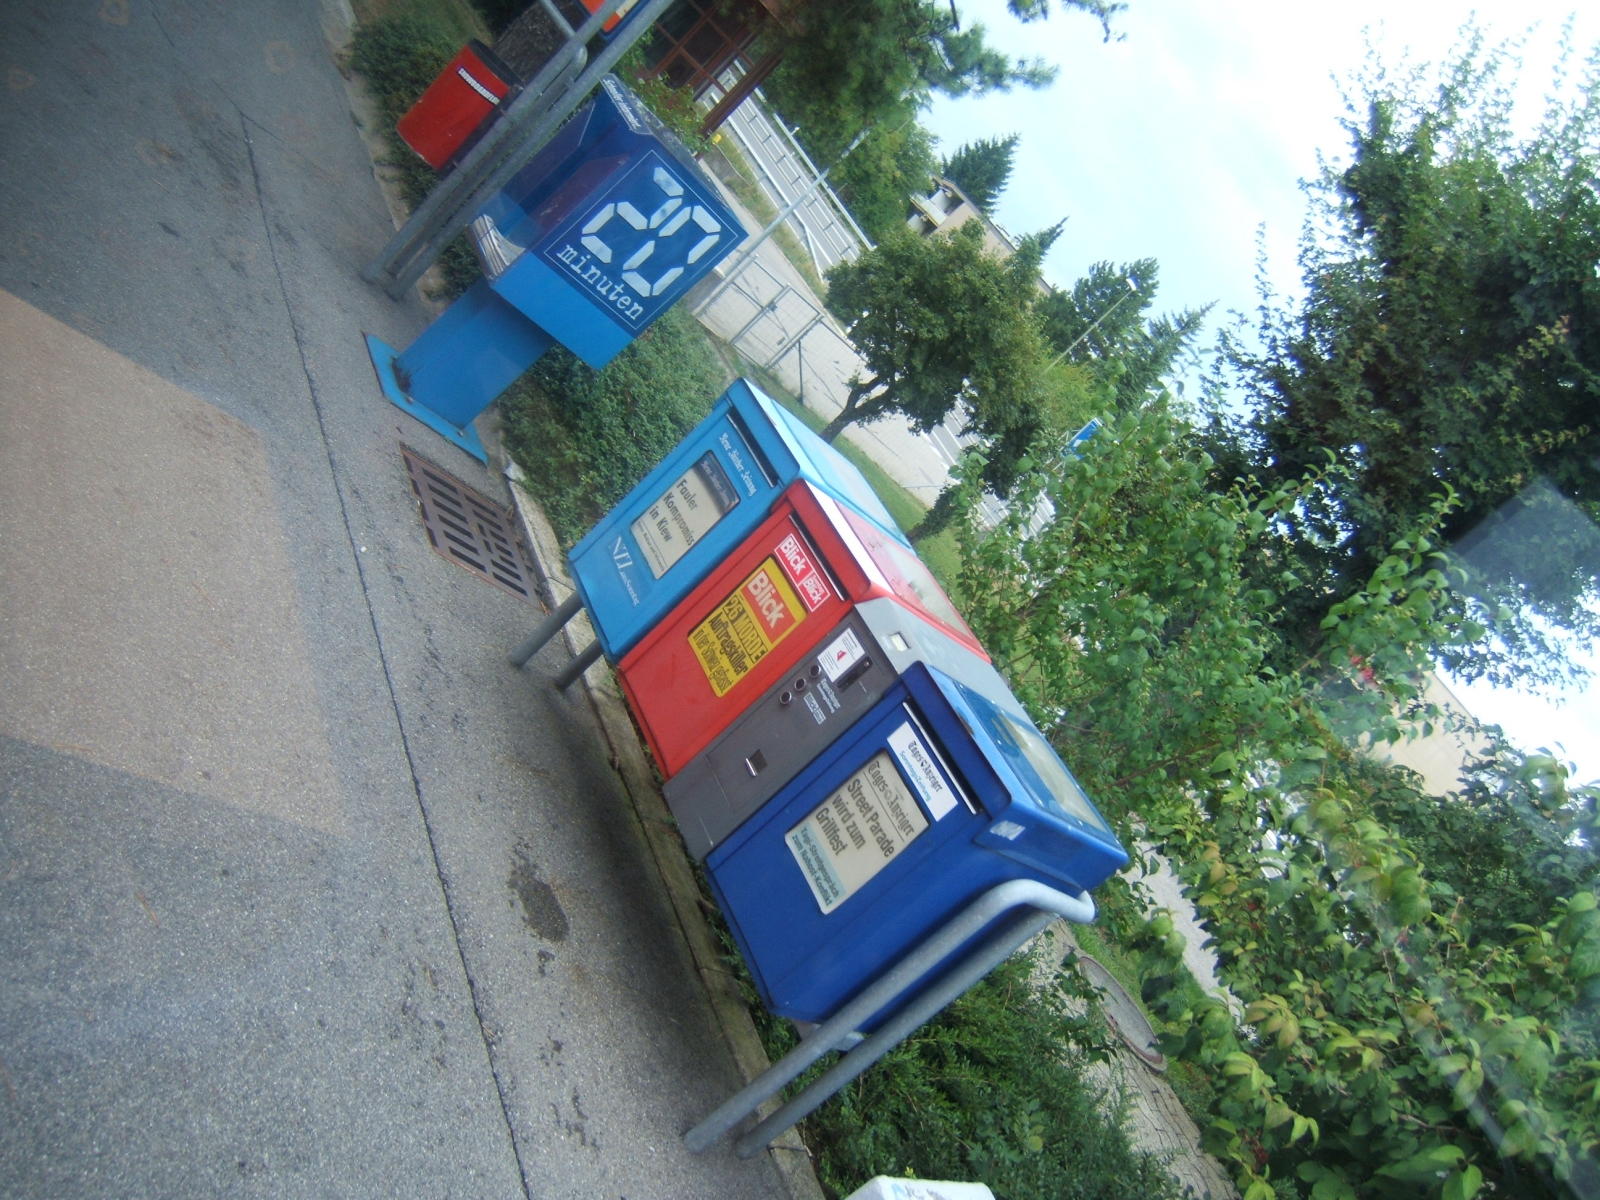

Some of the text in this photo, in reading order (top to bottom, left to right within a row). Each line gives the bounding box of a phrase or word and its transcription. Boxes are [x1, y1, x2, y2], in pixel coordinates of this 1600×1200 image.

[582, 167, 721, 298] 20
[556, 243, 643, 320] minuten
[663, 492, 695, 546] Kompromiss
[677, 480, 698, 511] Fauler
[649, 505, 660, 519] in
[656, 517, 673, 542] Kiew
[780, 539, 807, 575] Blick
[748, 572, 784, 628] Blick
[802, 578, 823, 603] Blick
[709, 614, 748, 675] Auftragskiller
[867, 760, 889, 792] Tages
[816, 807, 848, 855] Grillfest
[832, 794, 866, 849] wird zum
[847, 778, 896, 857] Street Parade
